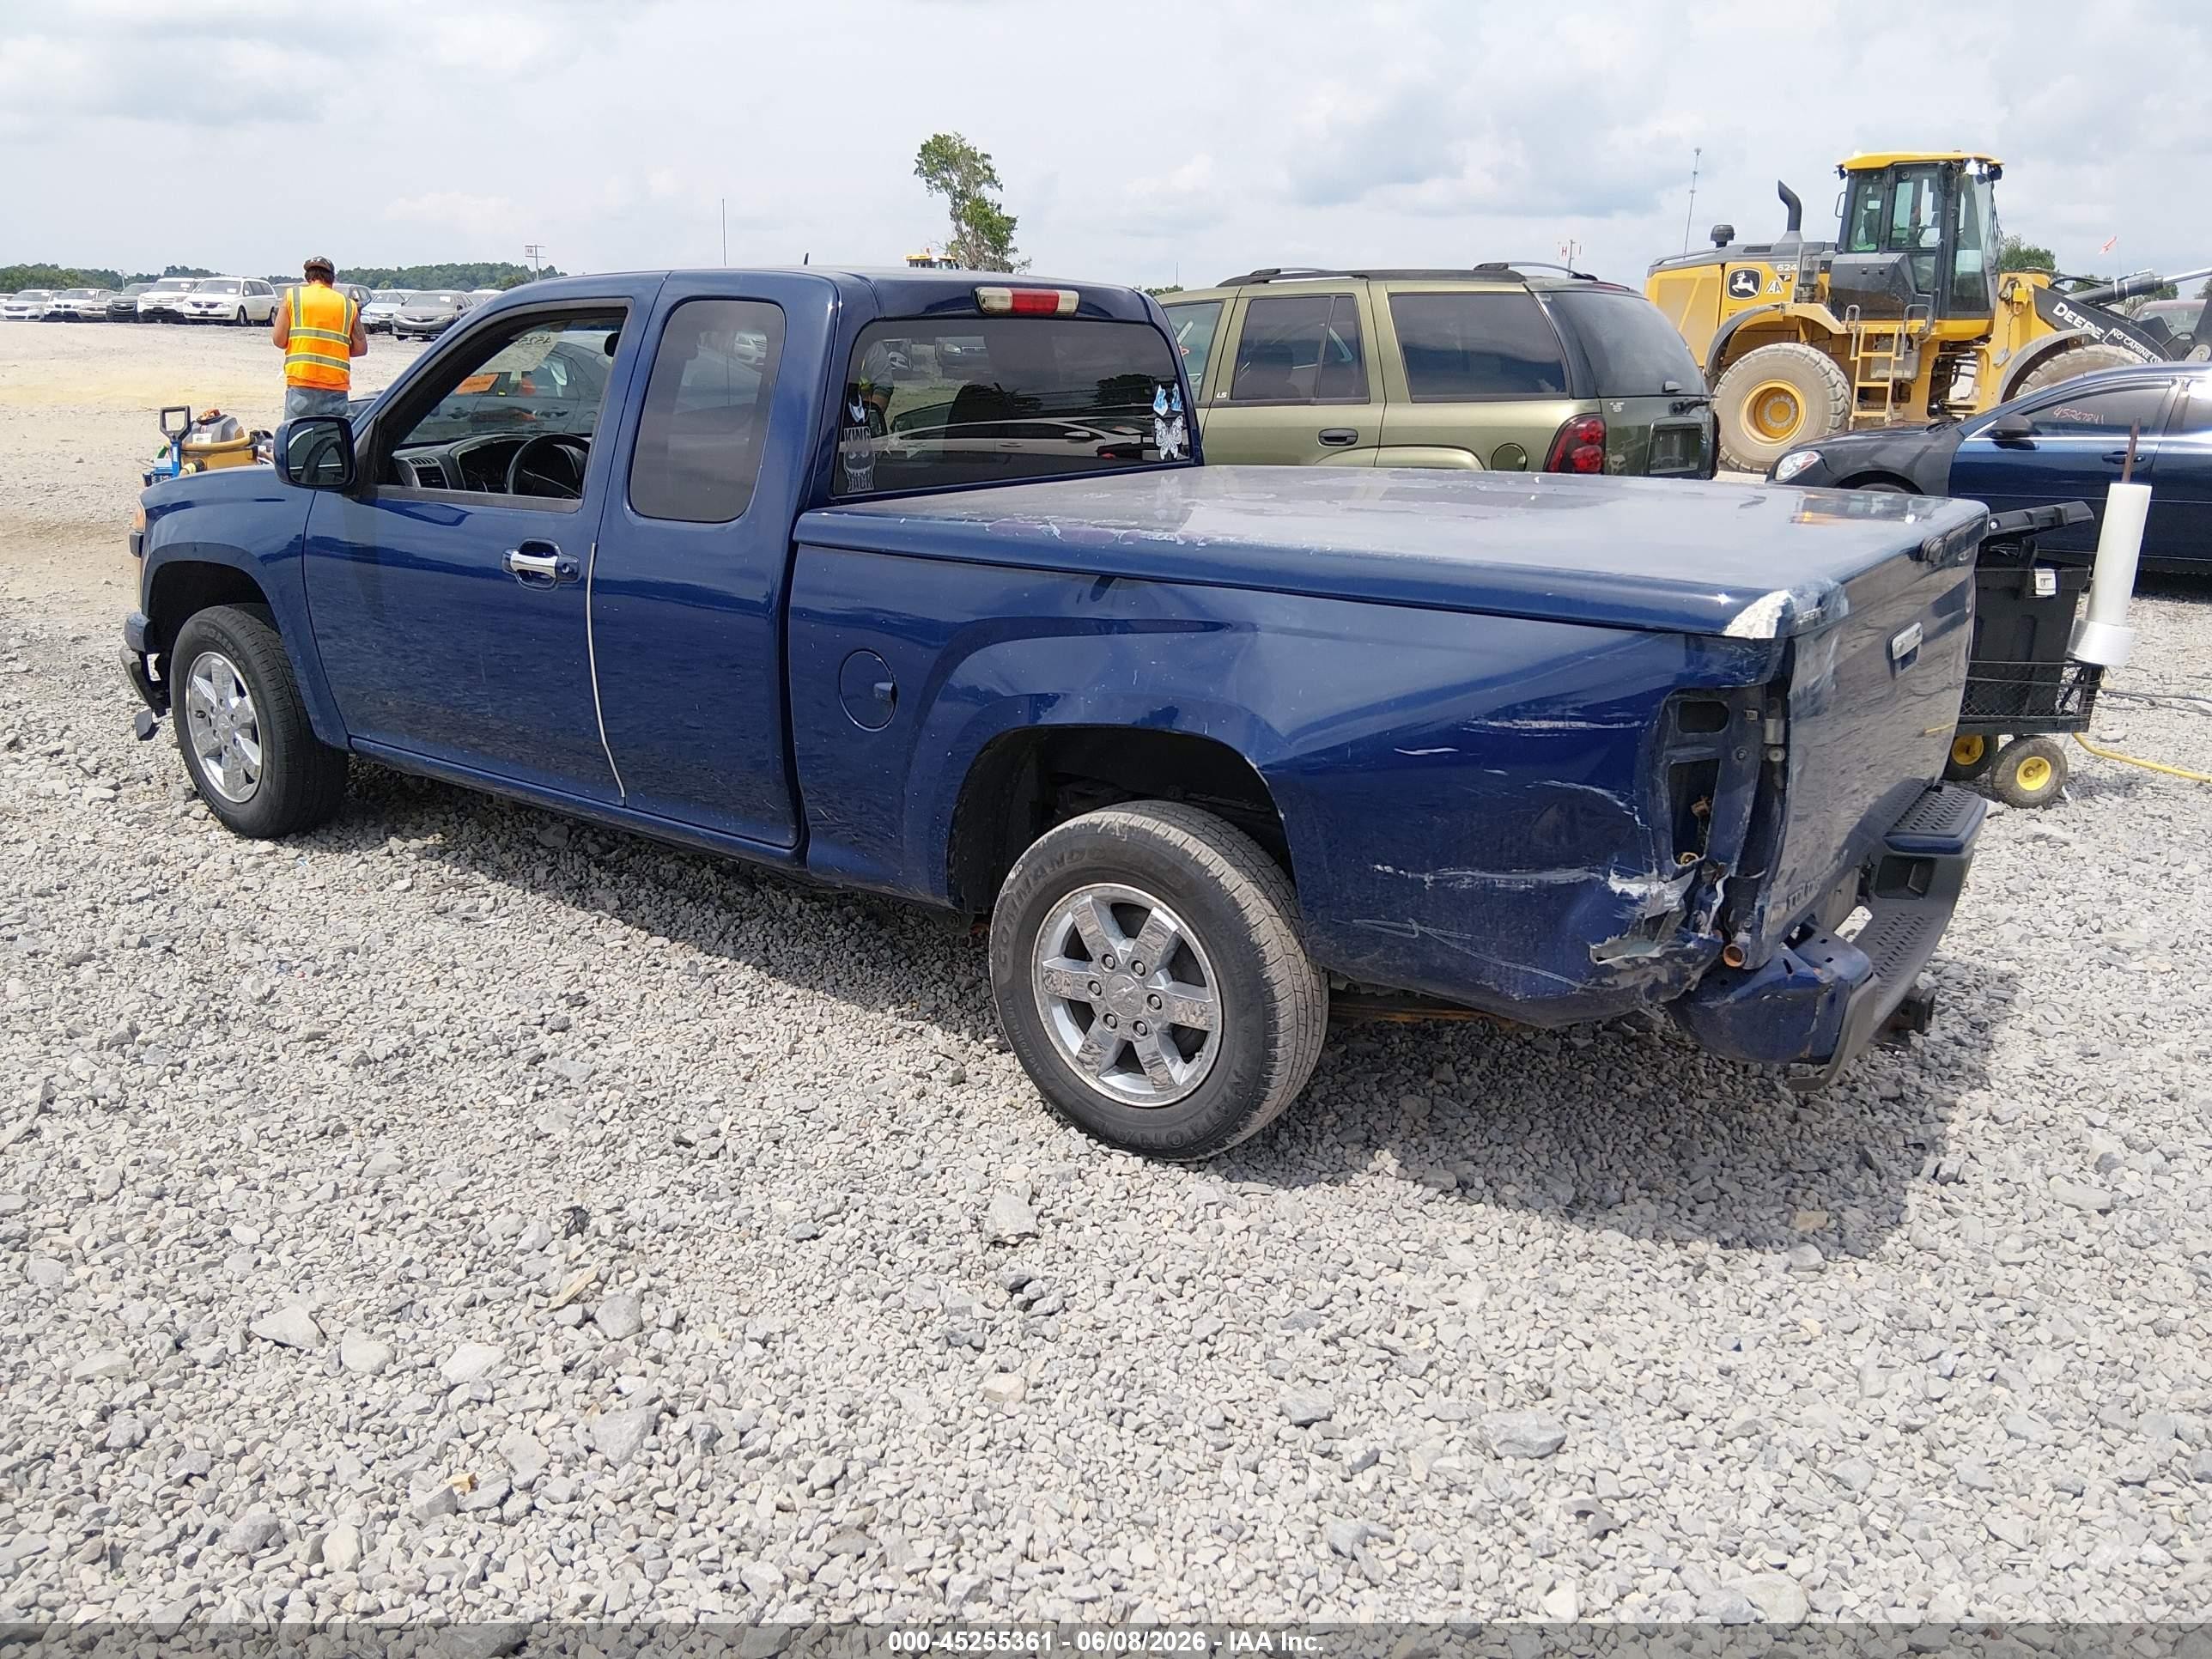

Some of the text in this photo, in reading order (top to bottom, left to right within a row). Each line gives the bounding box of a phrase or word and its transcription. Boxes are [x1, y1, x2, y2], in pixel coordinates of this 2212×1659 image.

[1776, 264, 1798, 272] 624
[2112, 328, 2124, 341] NO
[2123, 335, 2150, 360] CAMINE
